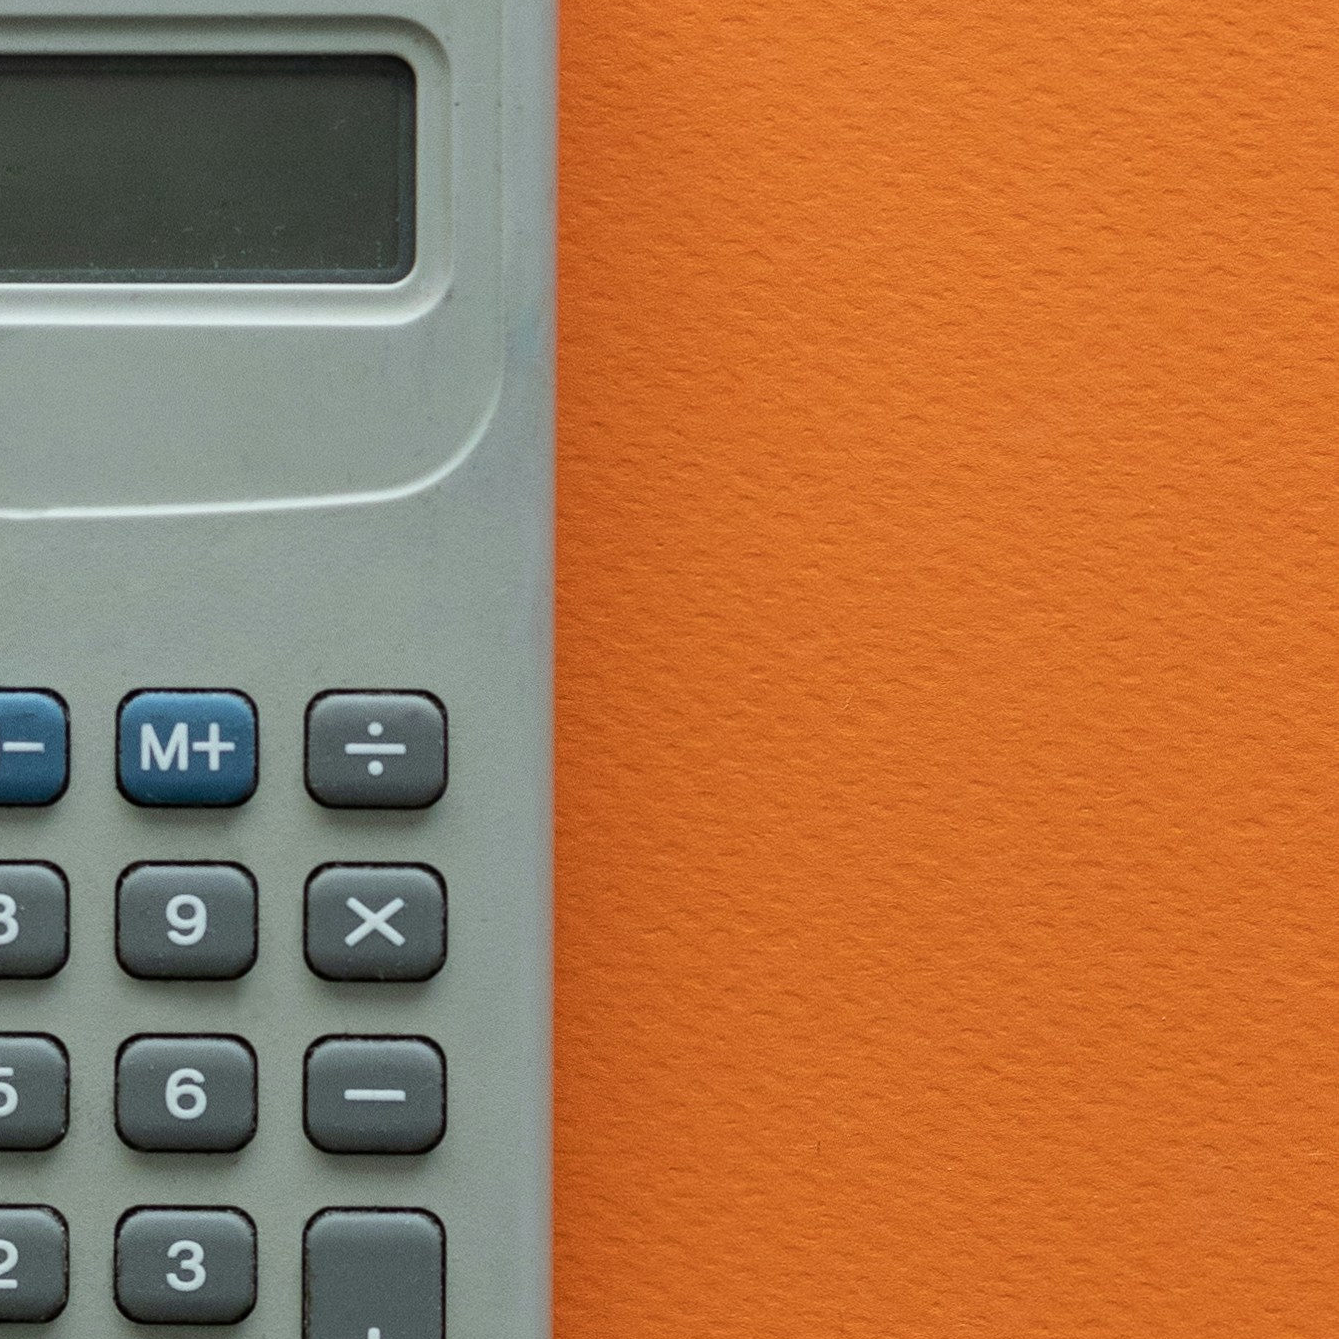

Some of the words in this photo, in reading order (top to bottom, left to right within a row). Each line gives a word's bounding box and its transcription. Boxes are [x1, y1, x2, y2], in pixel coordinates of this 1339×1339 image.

[140, 721, 236, 772] M+
[165, 893, 208, 946] 9
[164, 1066, 208, 1120] 6
[165, 1239, 207, 1293] 3
